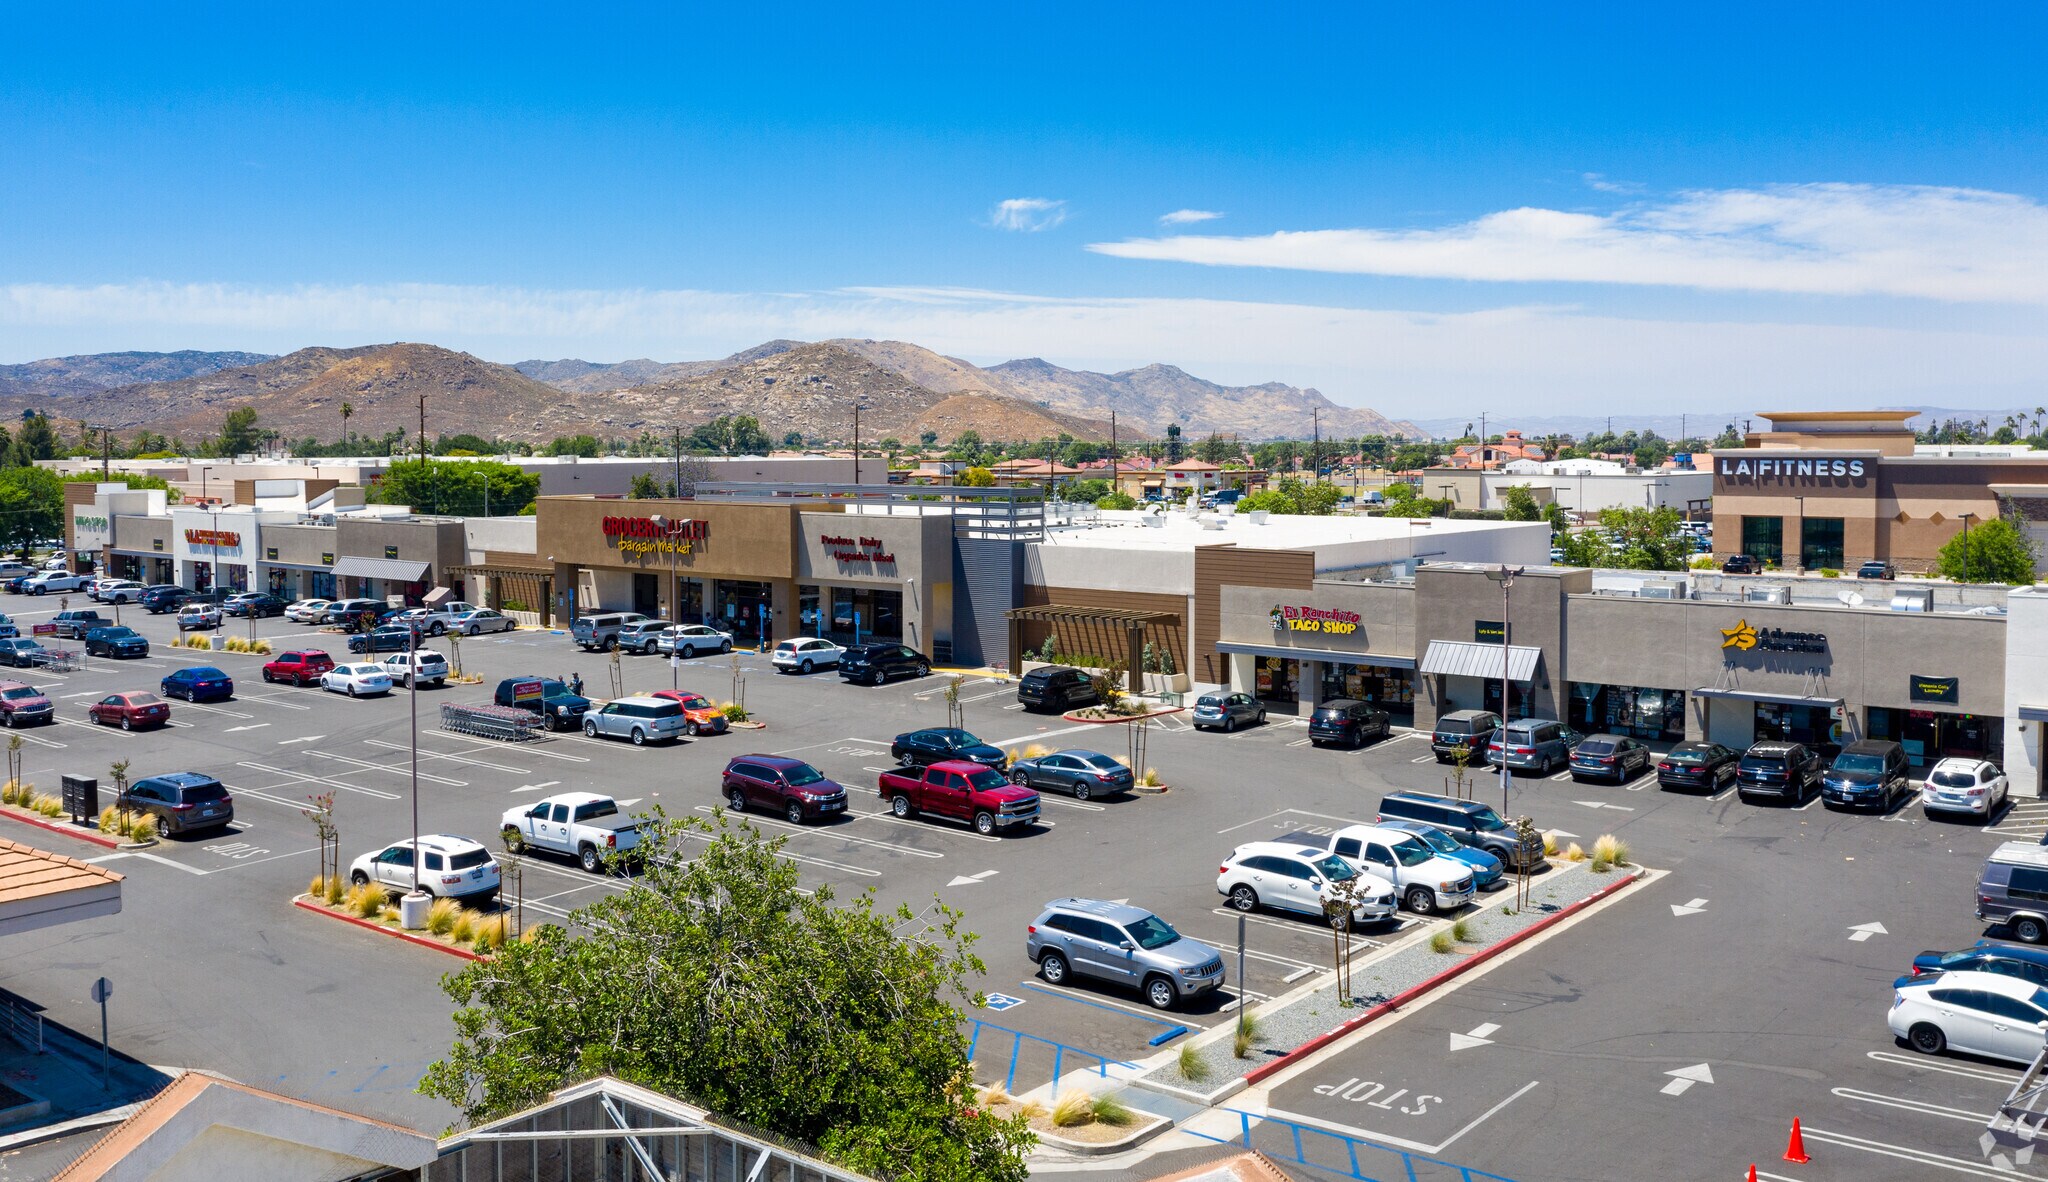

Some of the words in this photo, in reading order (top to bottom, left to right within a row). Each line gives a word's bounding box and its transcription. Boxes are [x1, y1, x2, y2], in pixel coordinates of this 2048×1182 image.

[1759, 459, 1865, 477] FITNESS
[602, 516, 660, 537] GROCERY
[618, 533, 657, 558] bargain
[658, 539, 692, 555] maket
[821, 534, 855, 546] Produce
[860, 536, 882, 549] Dairy
[834, 550, 871, 563] Organics
[873, 552, 895, 563] Meat
[1284, 606, 1298, 619] El
[1300, 606, 1361, 623] Ranchito
[1289, 619, 1320, 632] TACO
[1323, 621, 1357, 635] SHOP
[1760, 627, 1827, 641] Advance
[827, 746, 886, 757] STOP
[201, 842, 271, 859] STOP
[1312, 1077, 1443, 1116] STOP
